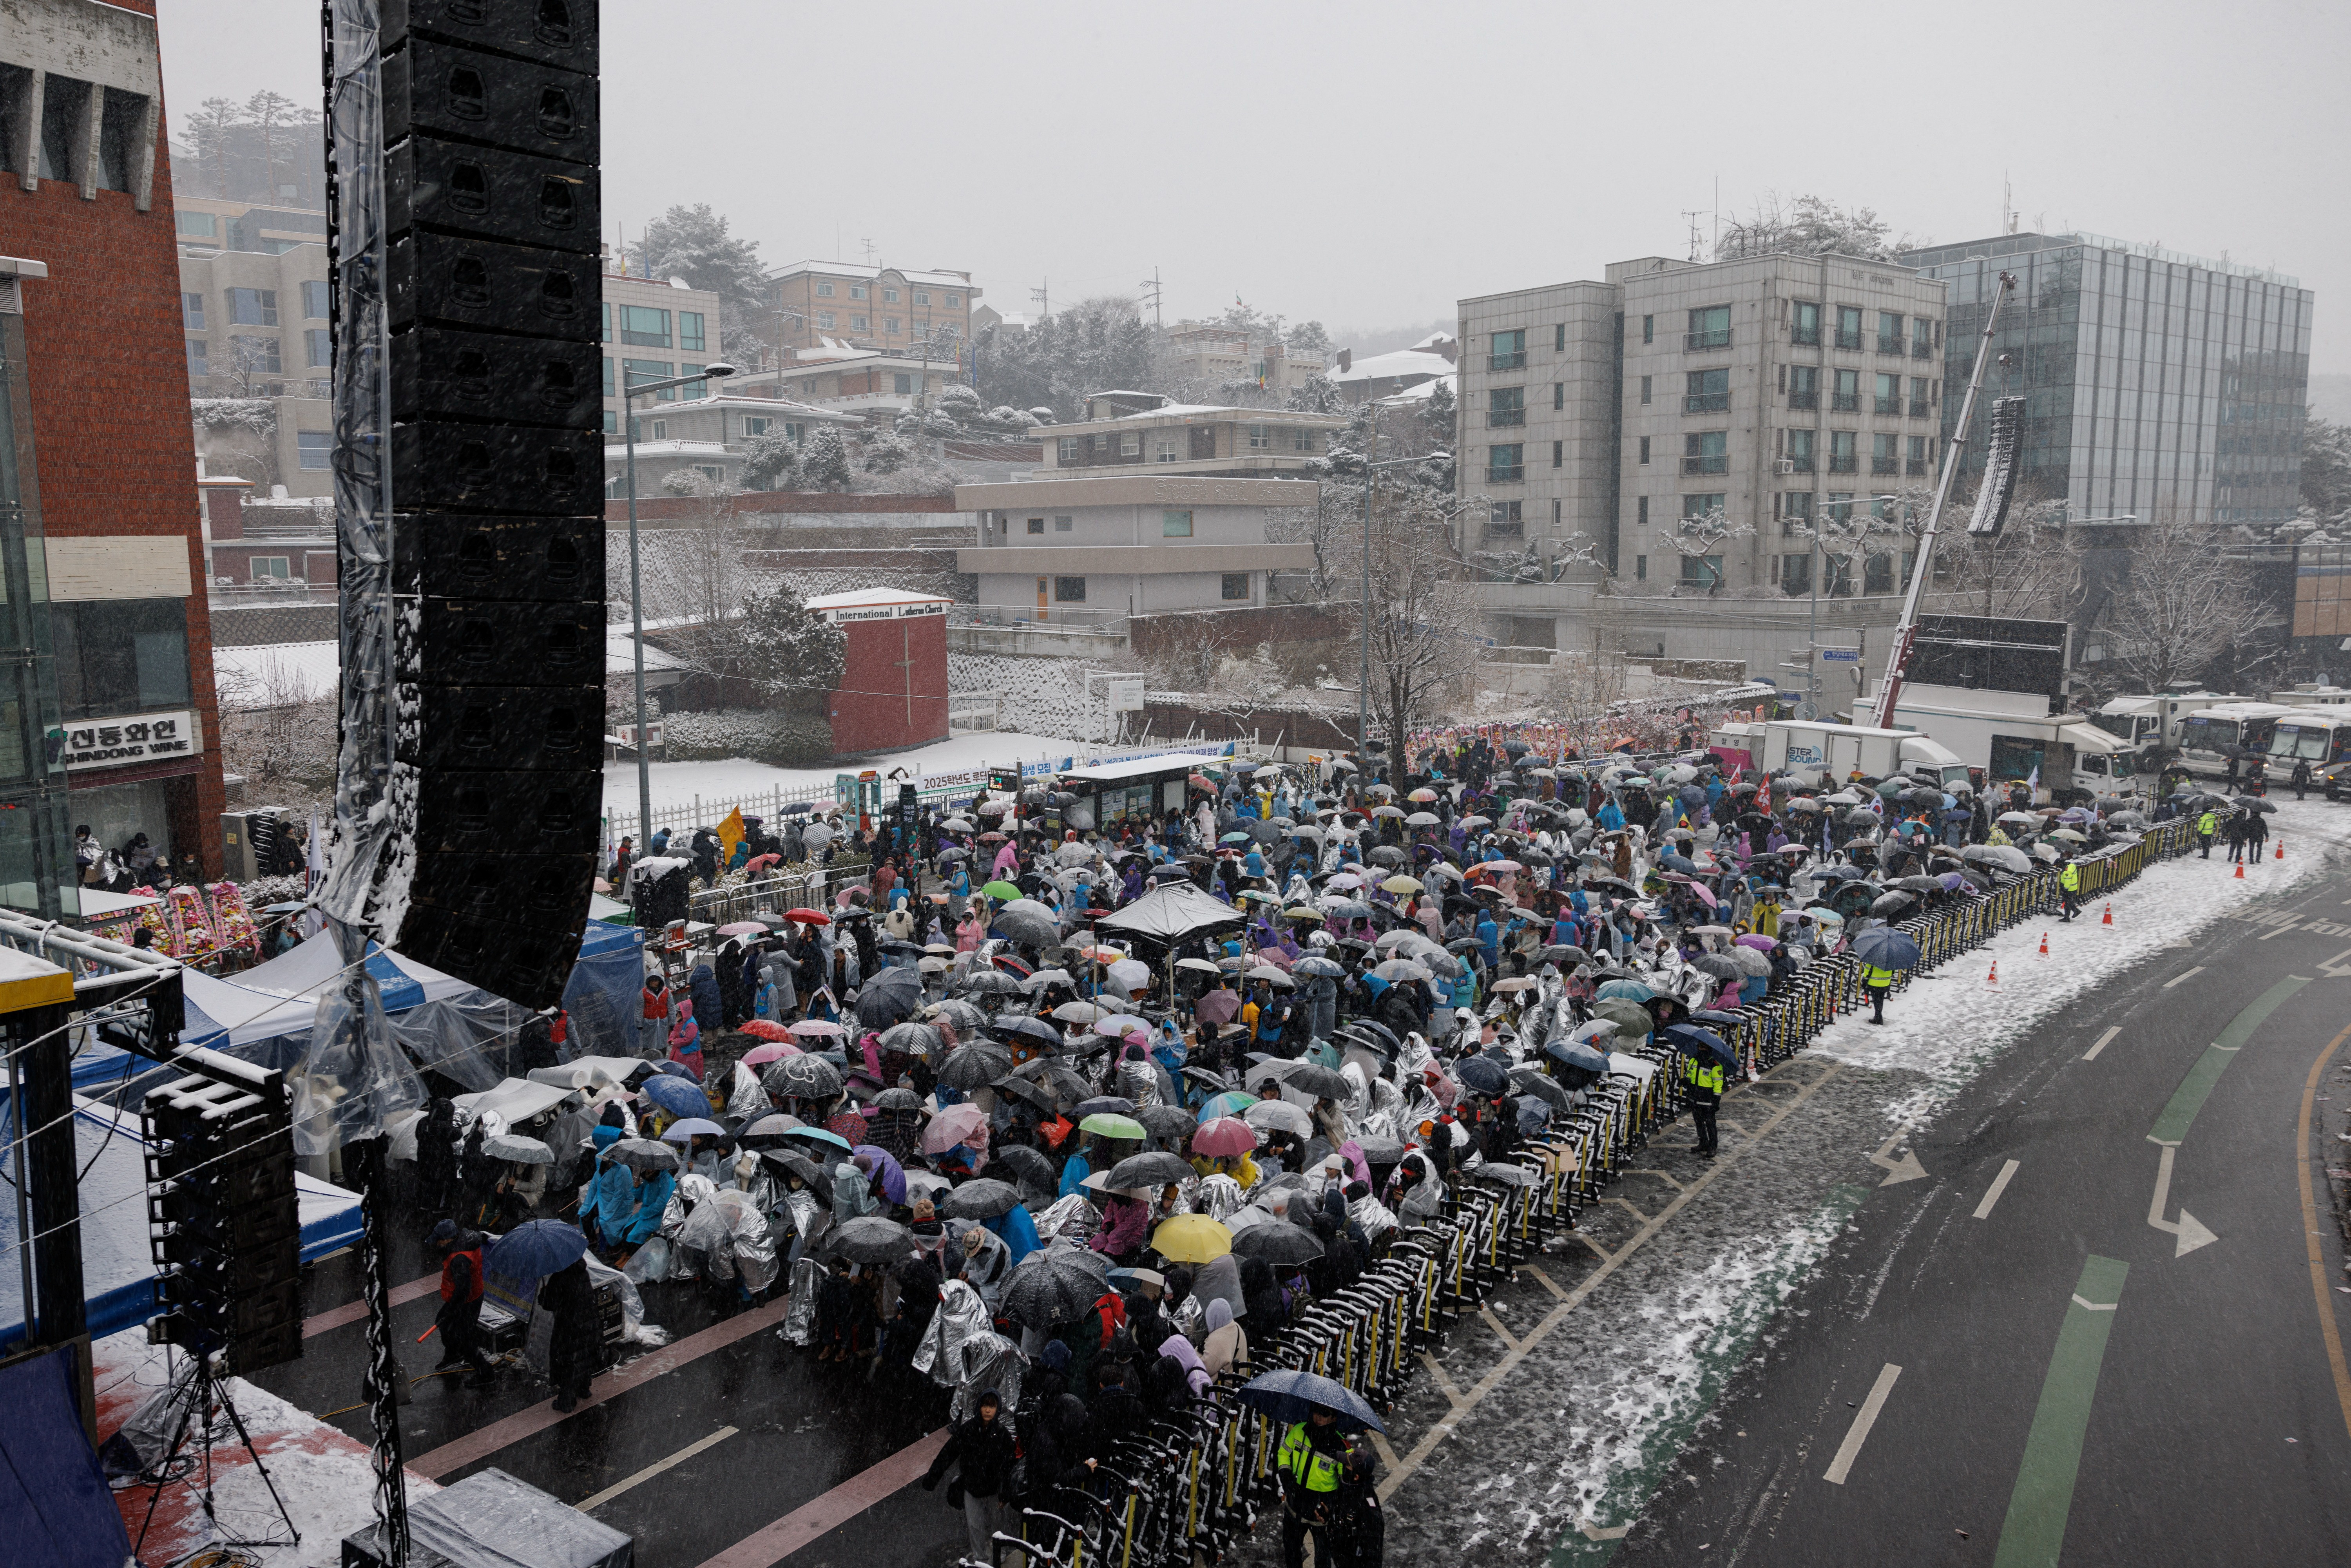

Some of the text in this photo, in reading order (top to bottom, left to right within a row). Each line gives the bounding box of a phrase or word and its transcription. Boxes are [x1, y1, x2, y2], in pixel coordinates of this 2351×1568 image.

[1155, 478, 1310, 503] Sport and Casual
[836, 603, 943, 620] International Lutheran Church
[71, 720, 176, 749] 신동와인
[60, 740, 188, 765] SHINDONG WINE
[1789, 755, 1822, 764] SOUND
[924, 773, 971, 789] 2025학년도
[1037, 763, 1051, 774] 모집
